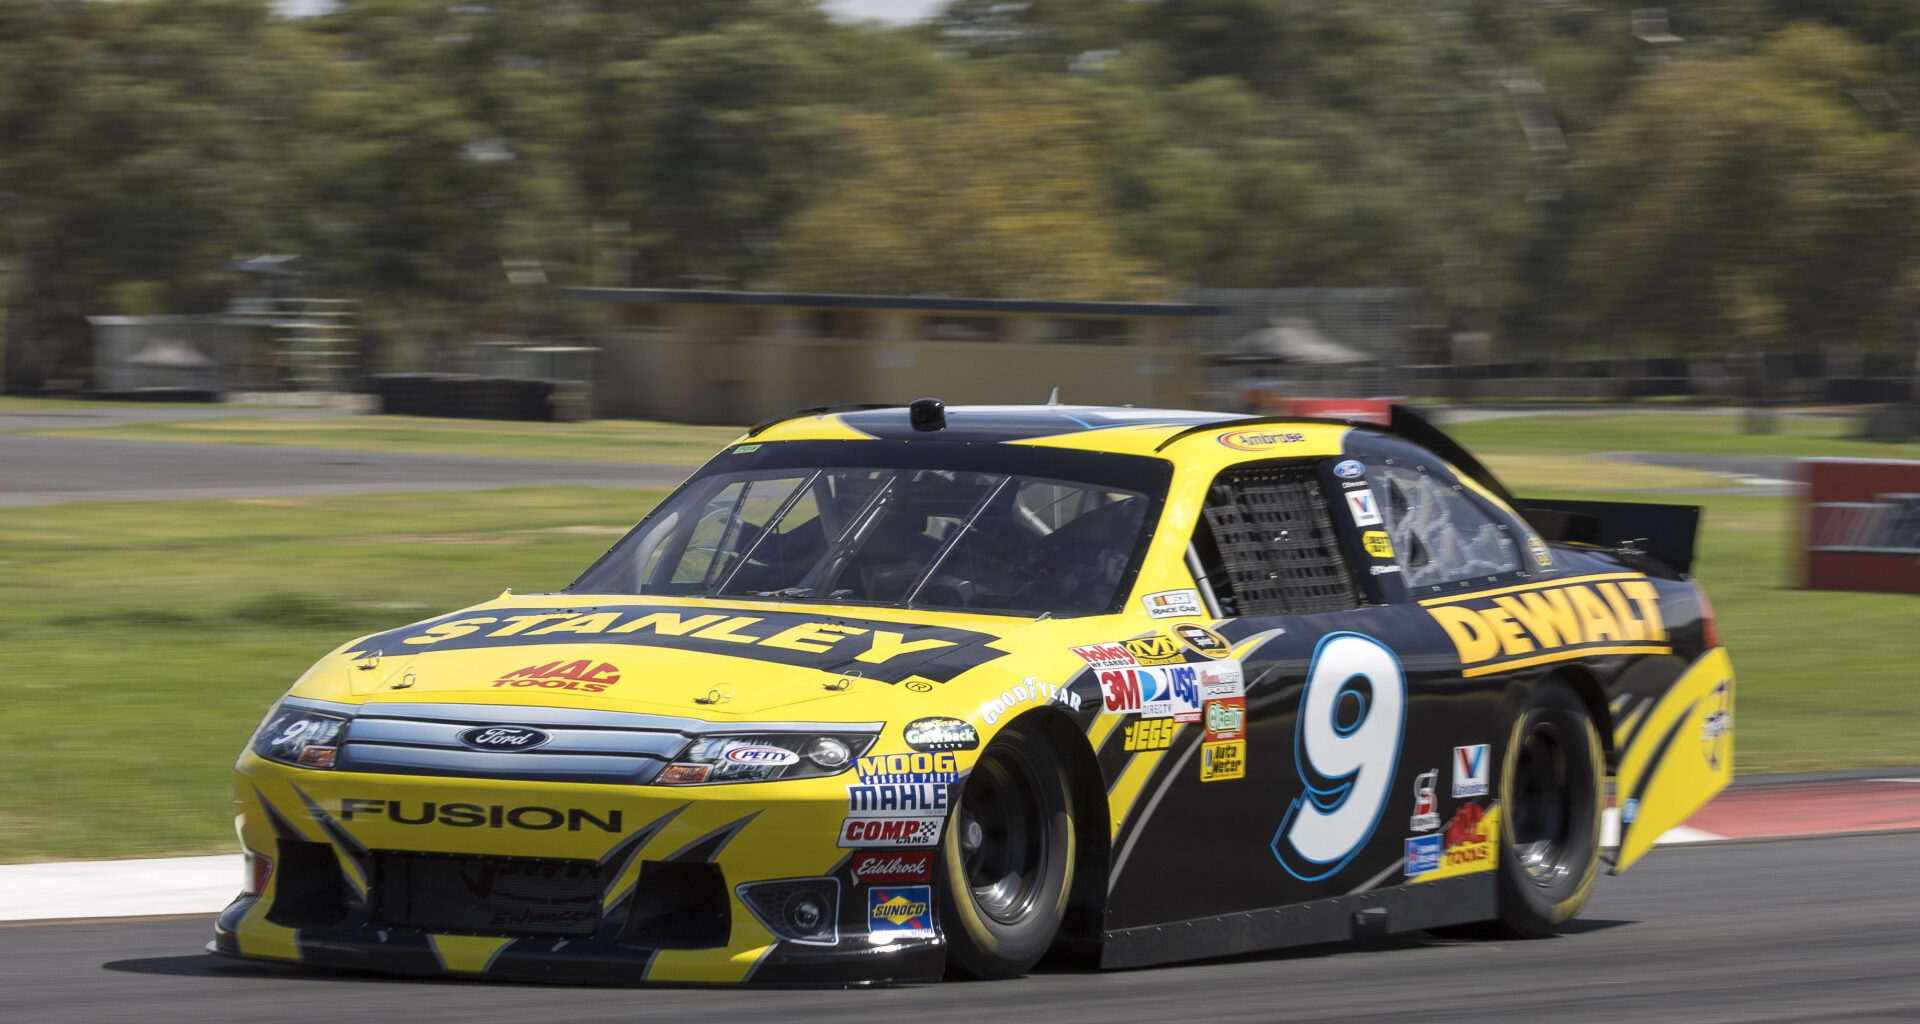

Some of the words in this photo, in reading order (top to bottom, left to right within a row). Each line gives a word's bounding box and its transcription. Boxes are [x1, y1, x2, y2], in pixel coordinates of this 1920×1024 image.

[1238, 433, 1305, 445] Ambrose
[404, 612, 958, 664] STANLEY
[1072, 645, 1135, 665] Holley
[499, 659, 621, 685] MAC
[491, 679, 609, 693] TOOLS
[1101, 670, 1141, 711] 3M
[1171, 667, 1199, 708] USG
[271, 720, 310, 746] 9
[475, 728, 533, 745] Ford
[1124, 718, 1172, 751] JEGS
[742, 751, 791, 761] PETTY
[857, 752, 956, 777] MOOG
[1273, 631, 1408, 879] 9
[864, 773, 914, 785] CHASSIS
[922, 772, 955, 784] PARTS
[849, 783, 946, 811] MAHLE
[340, 798, 623, 833] FUSION
[845, 821, 920, 841] COMP
[896, 836, 930, 844] CAMS
[857, 858, 926, 875] Edelbrock
[874, 903, 926, 916] SUNOCO
